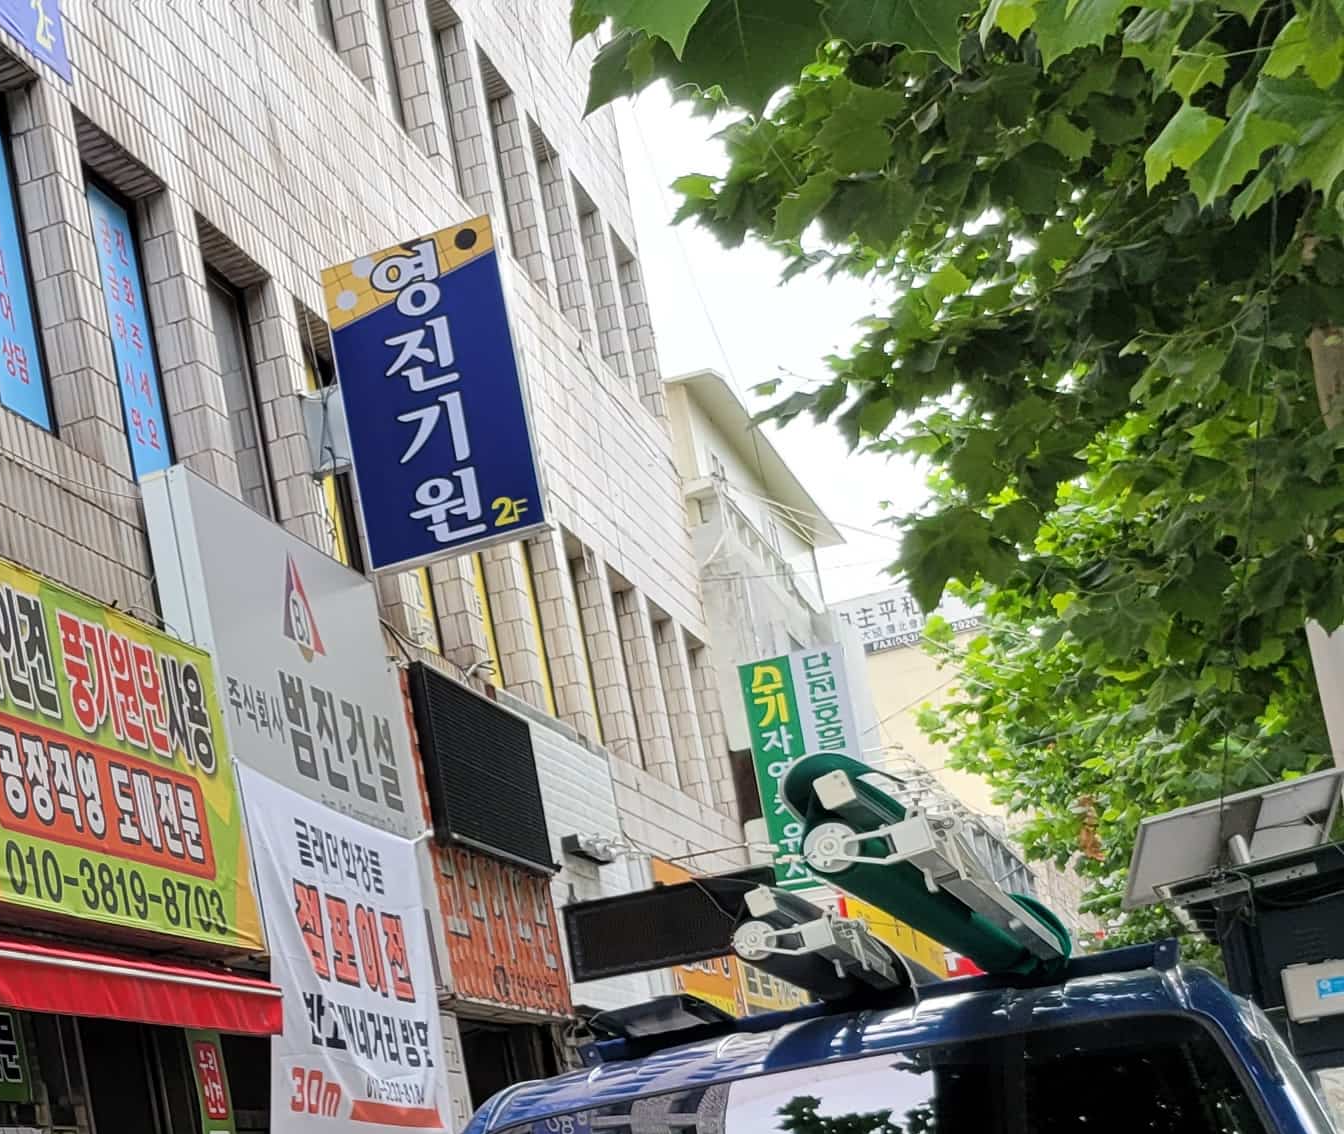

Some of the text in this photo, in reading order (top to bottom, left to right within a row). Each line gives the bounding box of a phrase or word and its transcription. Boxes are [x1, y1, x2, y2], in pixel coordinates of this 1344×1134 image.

[370, 238, 488, 545] 영진기원
[491, 495, 529, 527] 2F
[226, 670, 405, 813] 주식회사 범진건설
[108, 760, 207, 865] 도매전문
[5, 840, 229, 935] 010-3819-8703
[292, 878, 417, 1004] 점포이전
[290, 1066, 342, 1118] 30m
